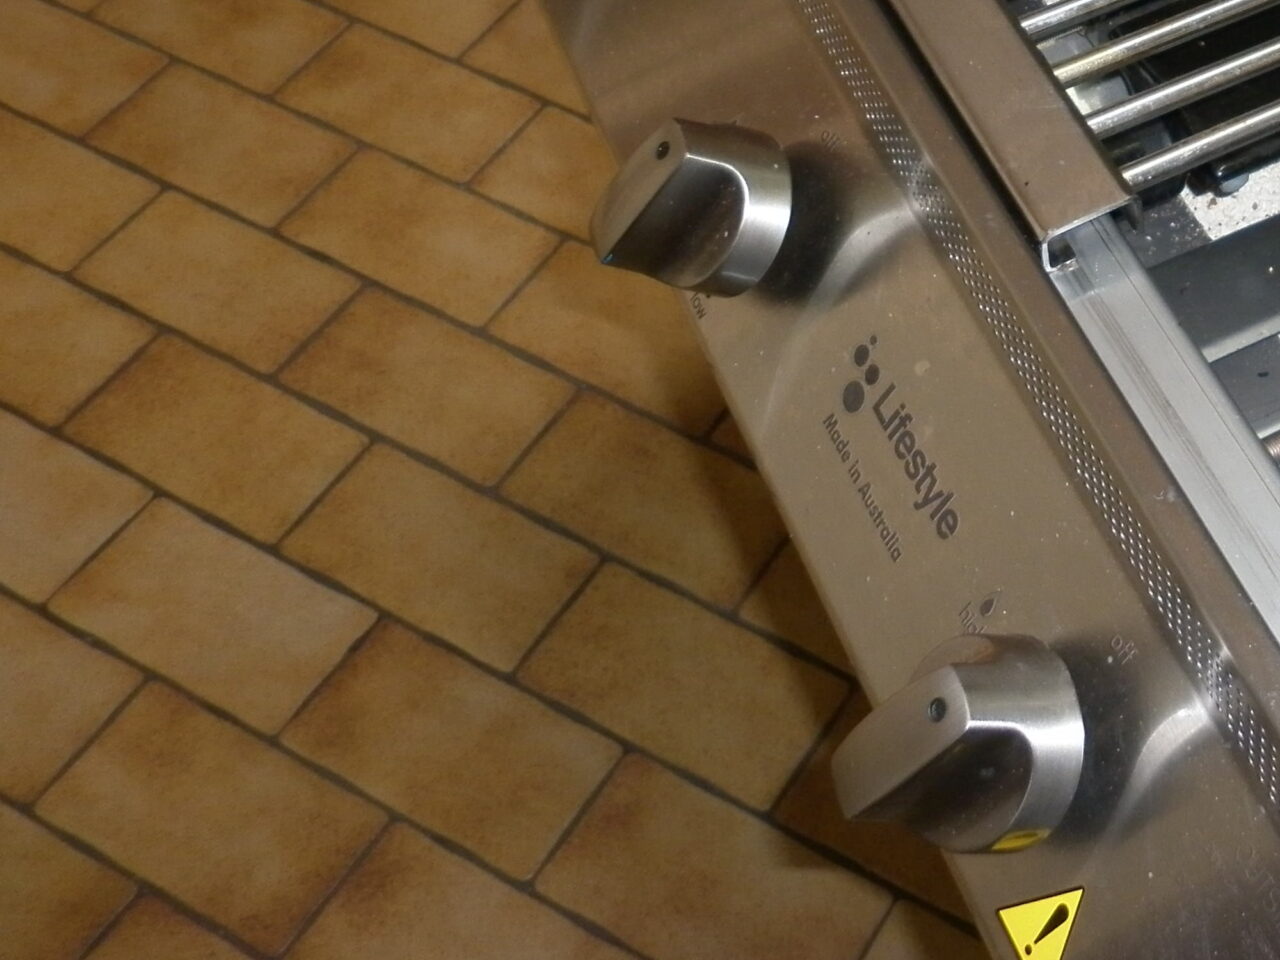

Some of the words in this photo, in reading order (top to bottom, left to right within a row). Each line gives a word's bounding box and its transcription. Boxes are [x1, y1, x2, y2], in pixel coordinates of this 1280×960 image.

[823, 413, 851, 463] Made
[848, 460, 862, 484] in
[857, 482, 902, 563] Australia
[872, 382, 959, 540] Lifestyle
